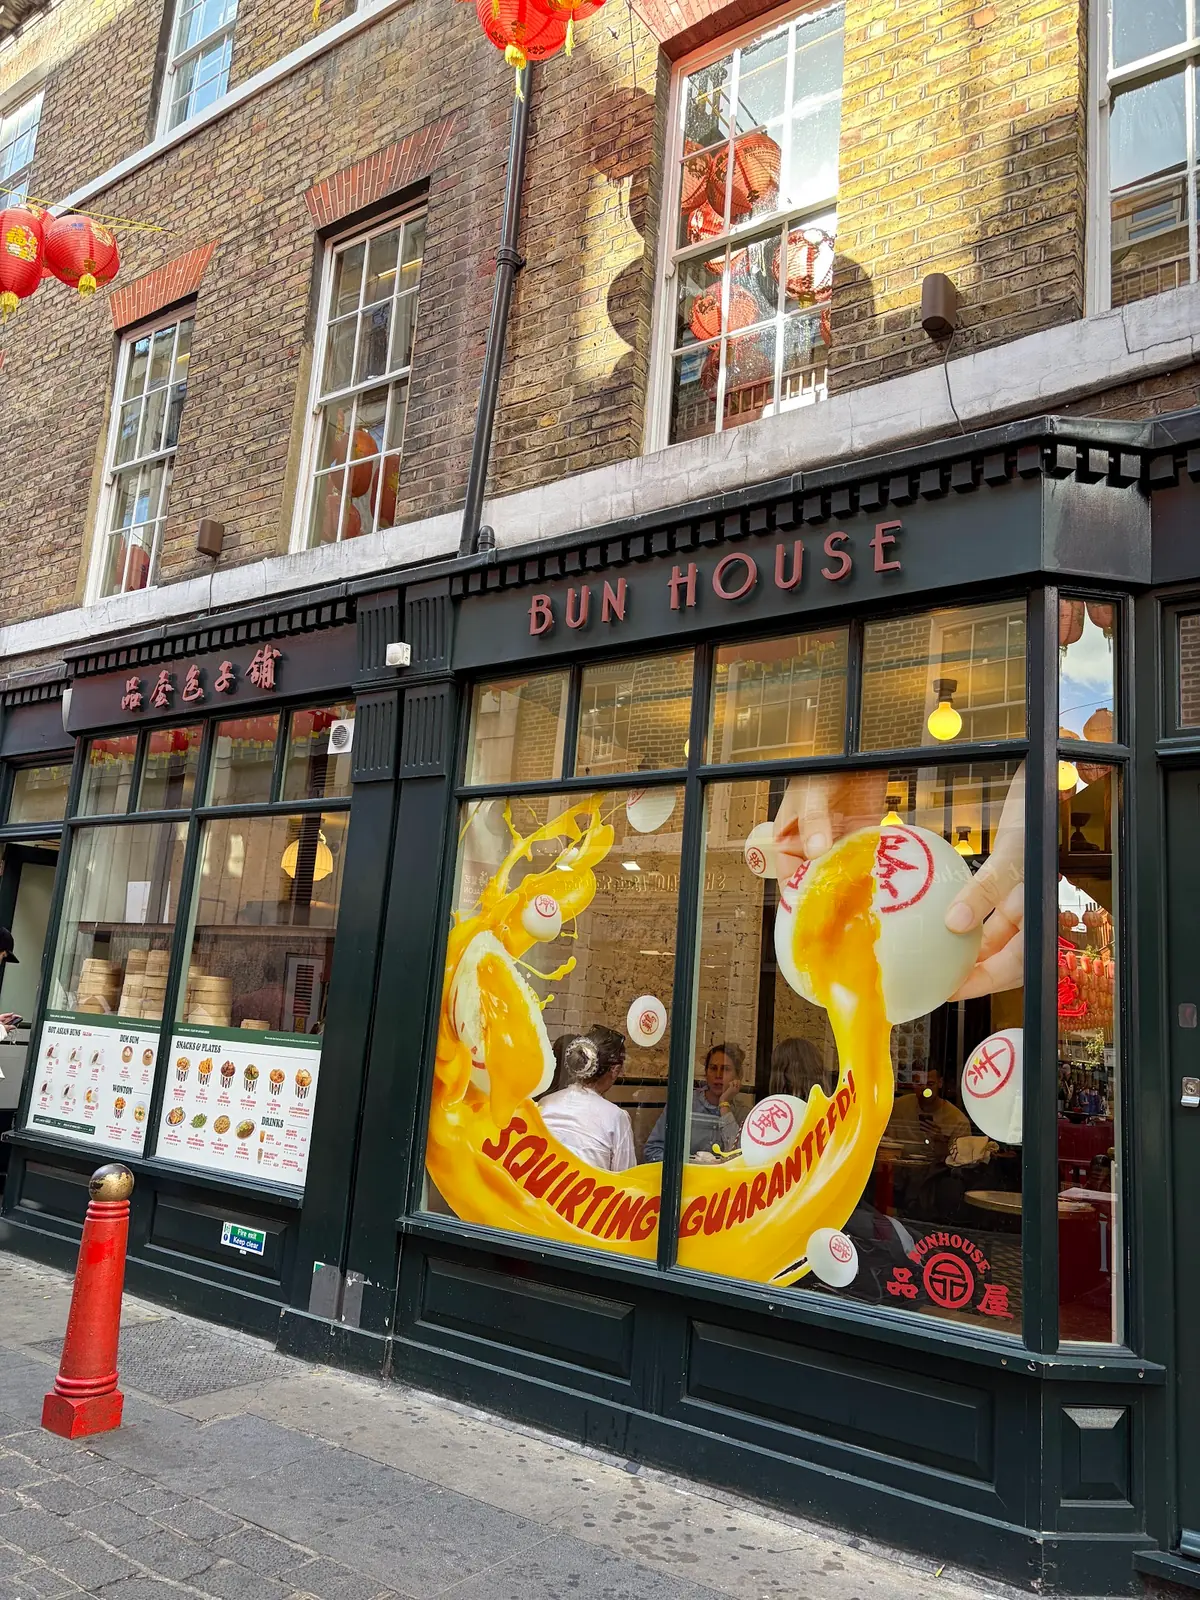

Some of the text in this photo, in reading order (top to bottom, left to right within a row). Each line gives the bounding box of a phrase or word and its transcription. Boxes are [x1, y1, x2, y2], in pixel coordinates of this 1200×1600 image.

[528, 520, 902, 635] BUN HOUSE
[176, 1041, 195, 1051] SNACKS
[201, 1045, 221, 1053] PLATES
[112, 1084, 133, 1095] WONTON
[261, 1117, 284, 1128] DRINKS
[481, 1069, 858, 1242] SQUIRTING GUARANTEED!
[237, 1229, 257, 1240] Fire exit
[233, 1236, 259, 1249] Keep clear
[886, 1267, 919, 1299] 品
